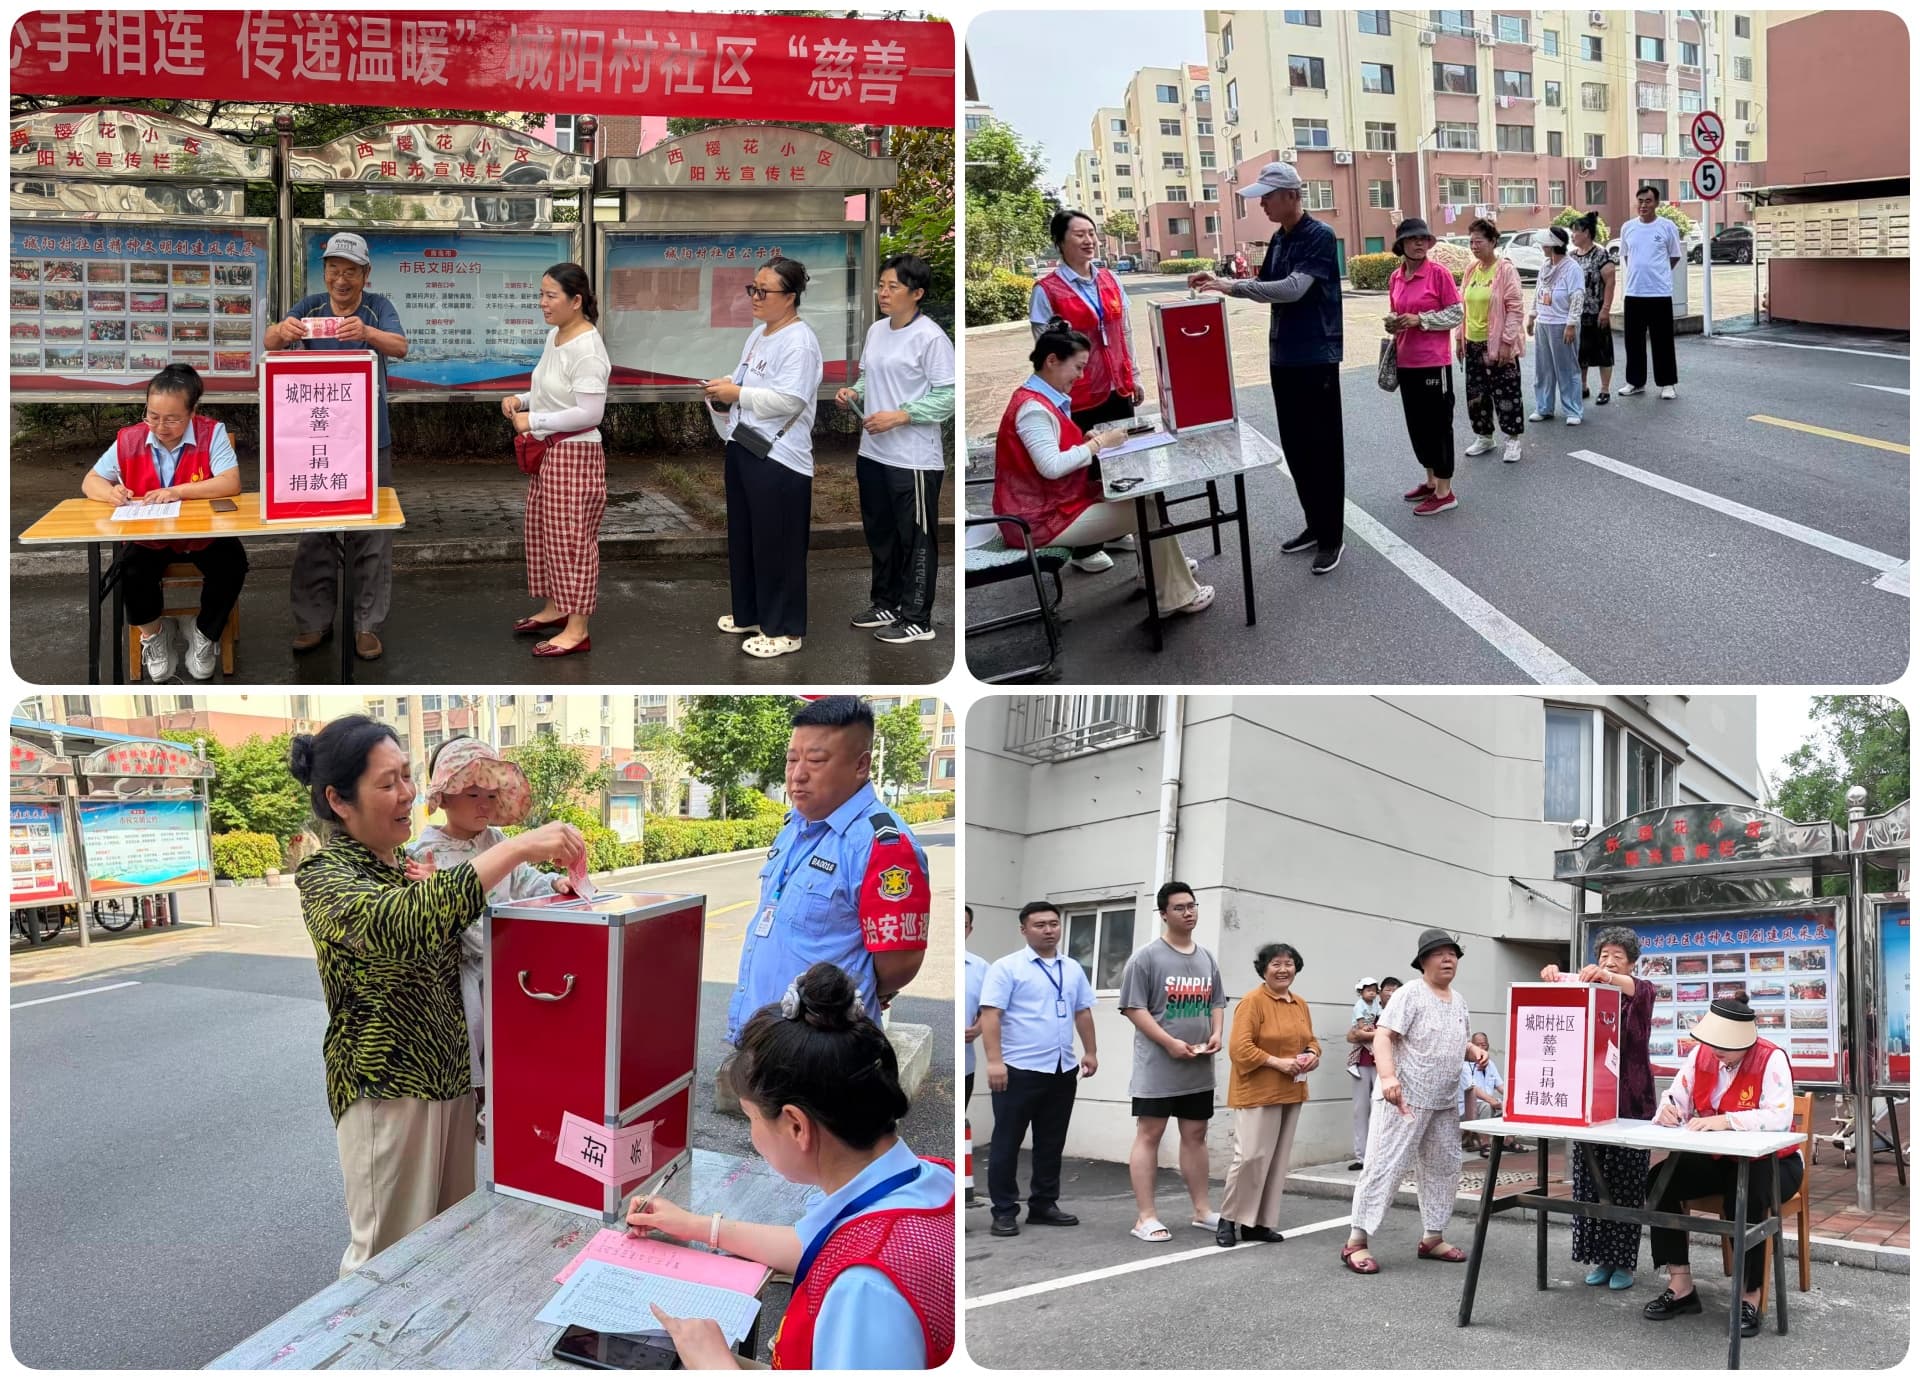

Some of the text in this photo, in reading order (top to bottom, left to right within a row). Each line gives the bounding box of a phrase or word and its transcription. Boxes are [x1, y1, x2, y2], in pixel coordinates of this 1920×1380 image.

[505, 23, 757, 96] 城阳村社区
[10, 122, 201, 155] 西樱花小区
[357, 133, 530, 163] 西樱花小区
[37, 150, 171, 170] 阳光宣传栏
[666, 138, 834, 167] 西樱花小区
[381, 161, 502, 179] 阳光宣传栏
[689, 166, 806, 182] 阳光宣传栏
[1702, 164, 1716, 191] 5
[22, 235, 256, 257] 城阳村社区精神文明创建风采展
[399, 261, 482, 274] 市民文明公约
[286, 383, 352, 403] 城阳村社区
[308, 406, 330, 469] 慈善一日捐
[289, 473, 348, 491] 捐款箱
[1525, 1014, 1575, 1032] 城阳村社区
[1539, 1034, 1557, 1088] 慈善一日捐
[1525, 1090, 1568, 1107] 捐款箱
